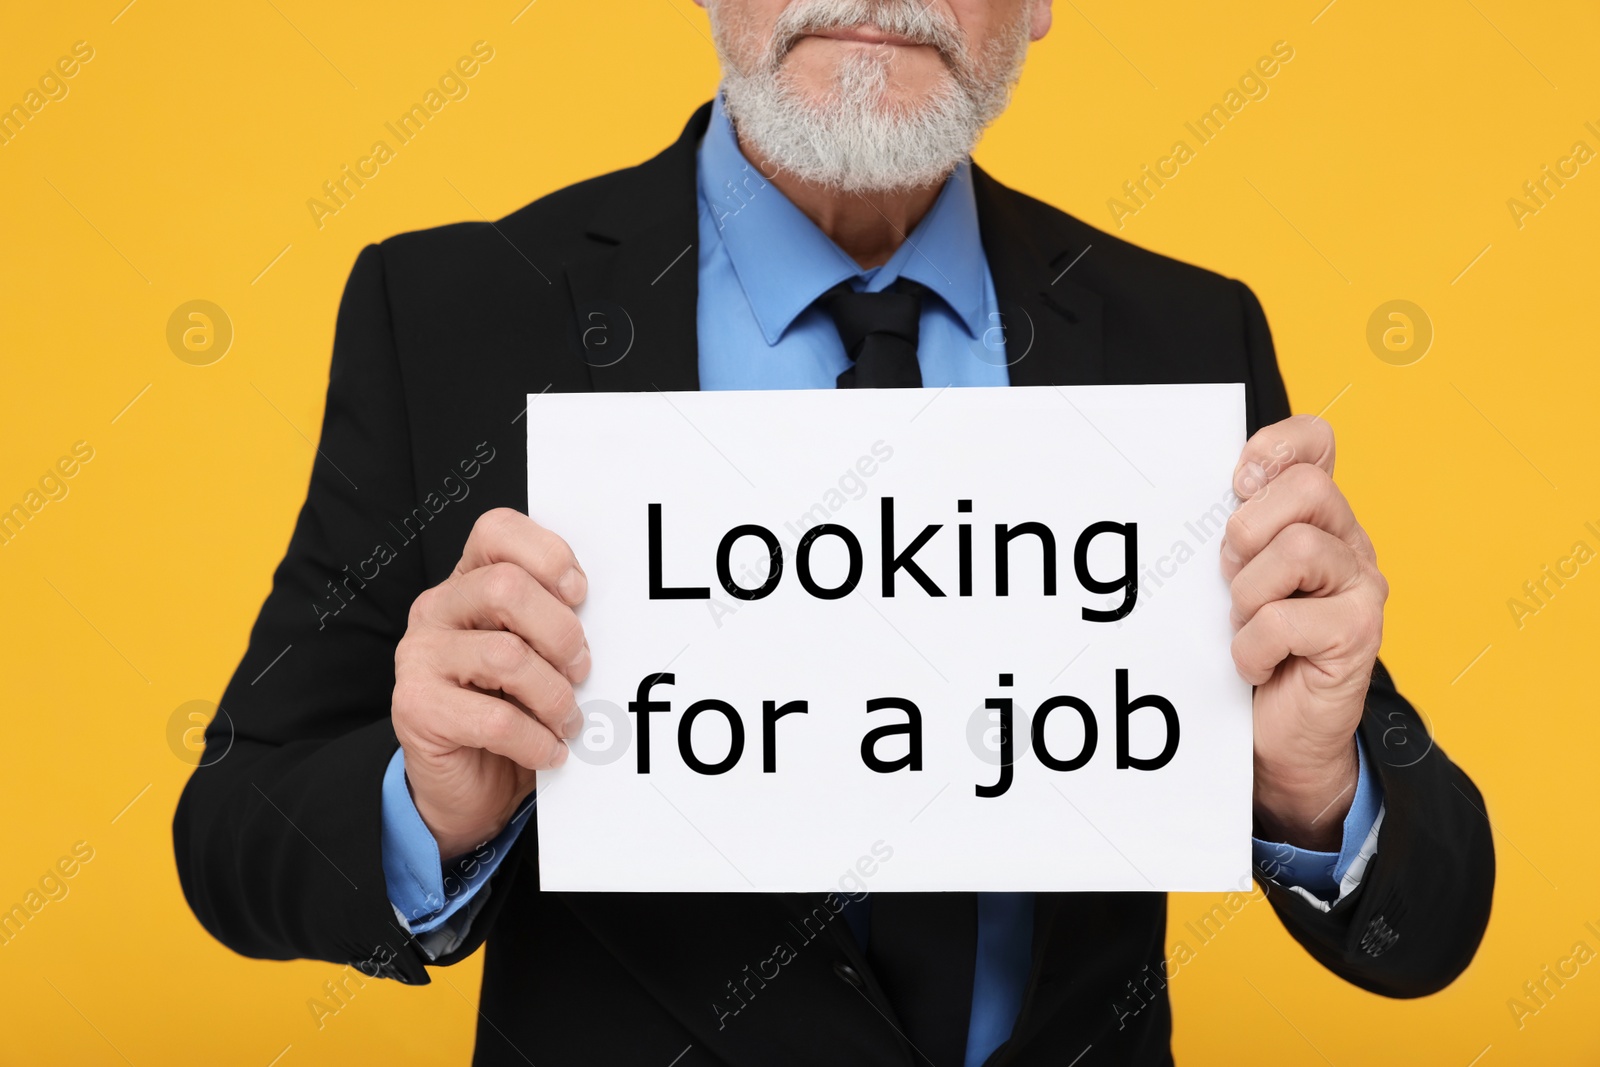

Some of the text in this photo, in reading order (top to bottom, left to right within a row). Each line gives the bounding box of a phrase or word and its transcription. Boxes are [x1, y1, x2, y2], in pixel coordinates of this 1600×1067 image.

[648, 496, 1139, 622] Looking
[628, 668, 1181, 798] for a job
